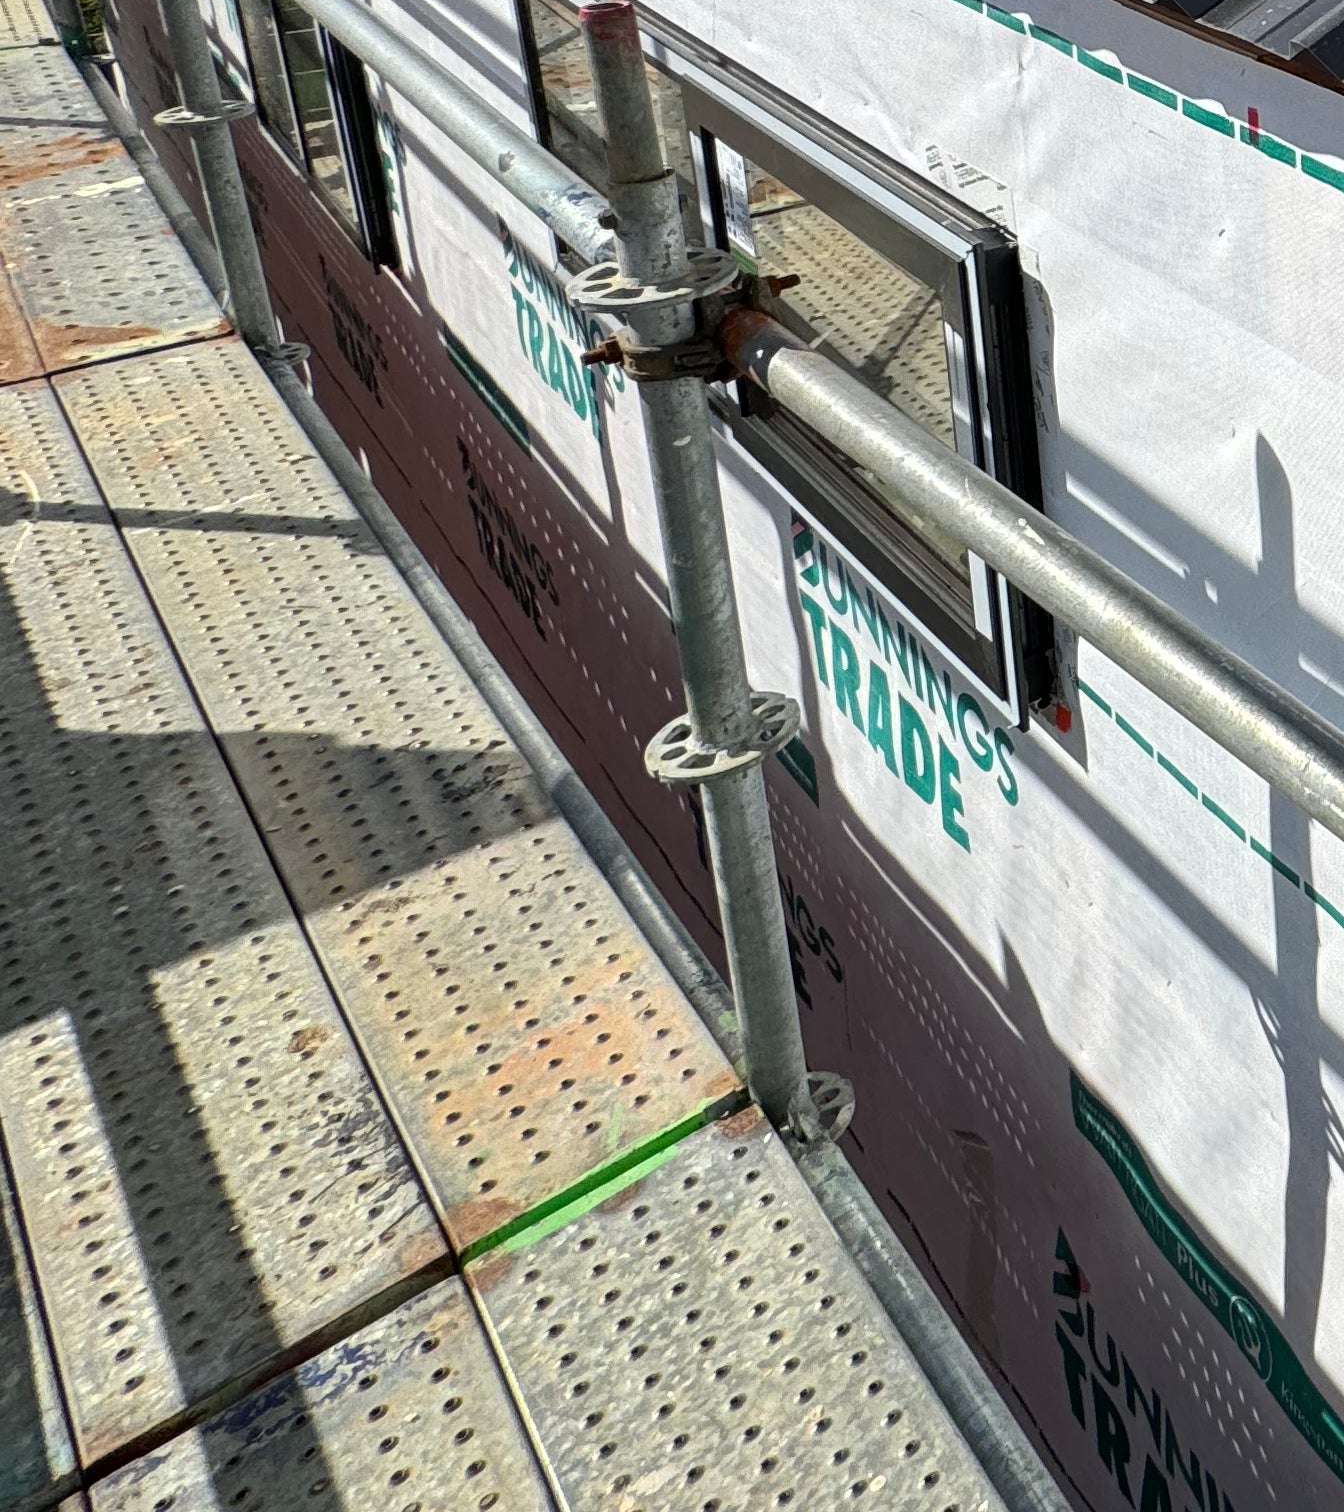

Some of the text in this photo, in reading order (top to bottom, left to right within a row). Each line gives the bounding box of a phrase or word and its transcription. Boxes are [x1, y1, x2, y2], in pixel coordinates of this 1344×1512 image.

[791, 506, 1019, 807] BUNNINGS
[798, 588, 971, 855] TRADE
[1175, 1244, 1219, 1308] Plus
